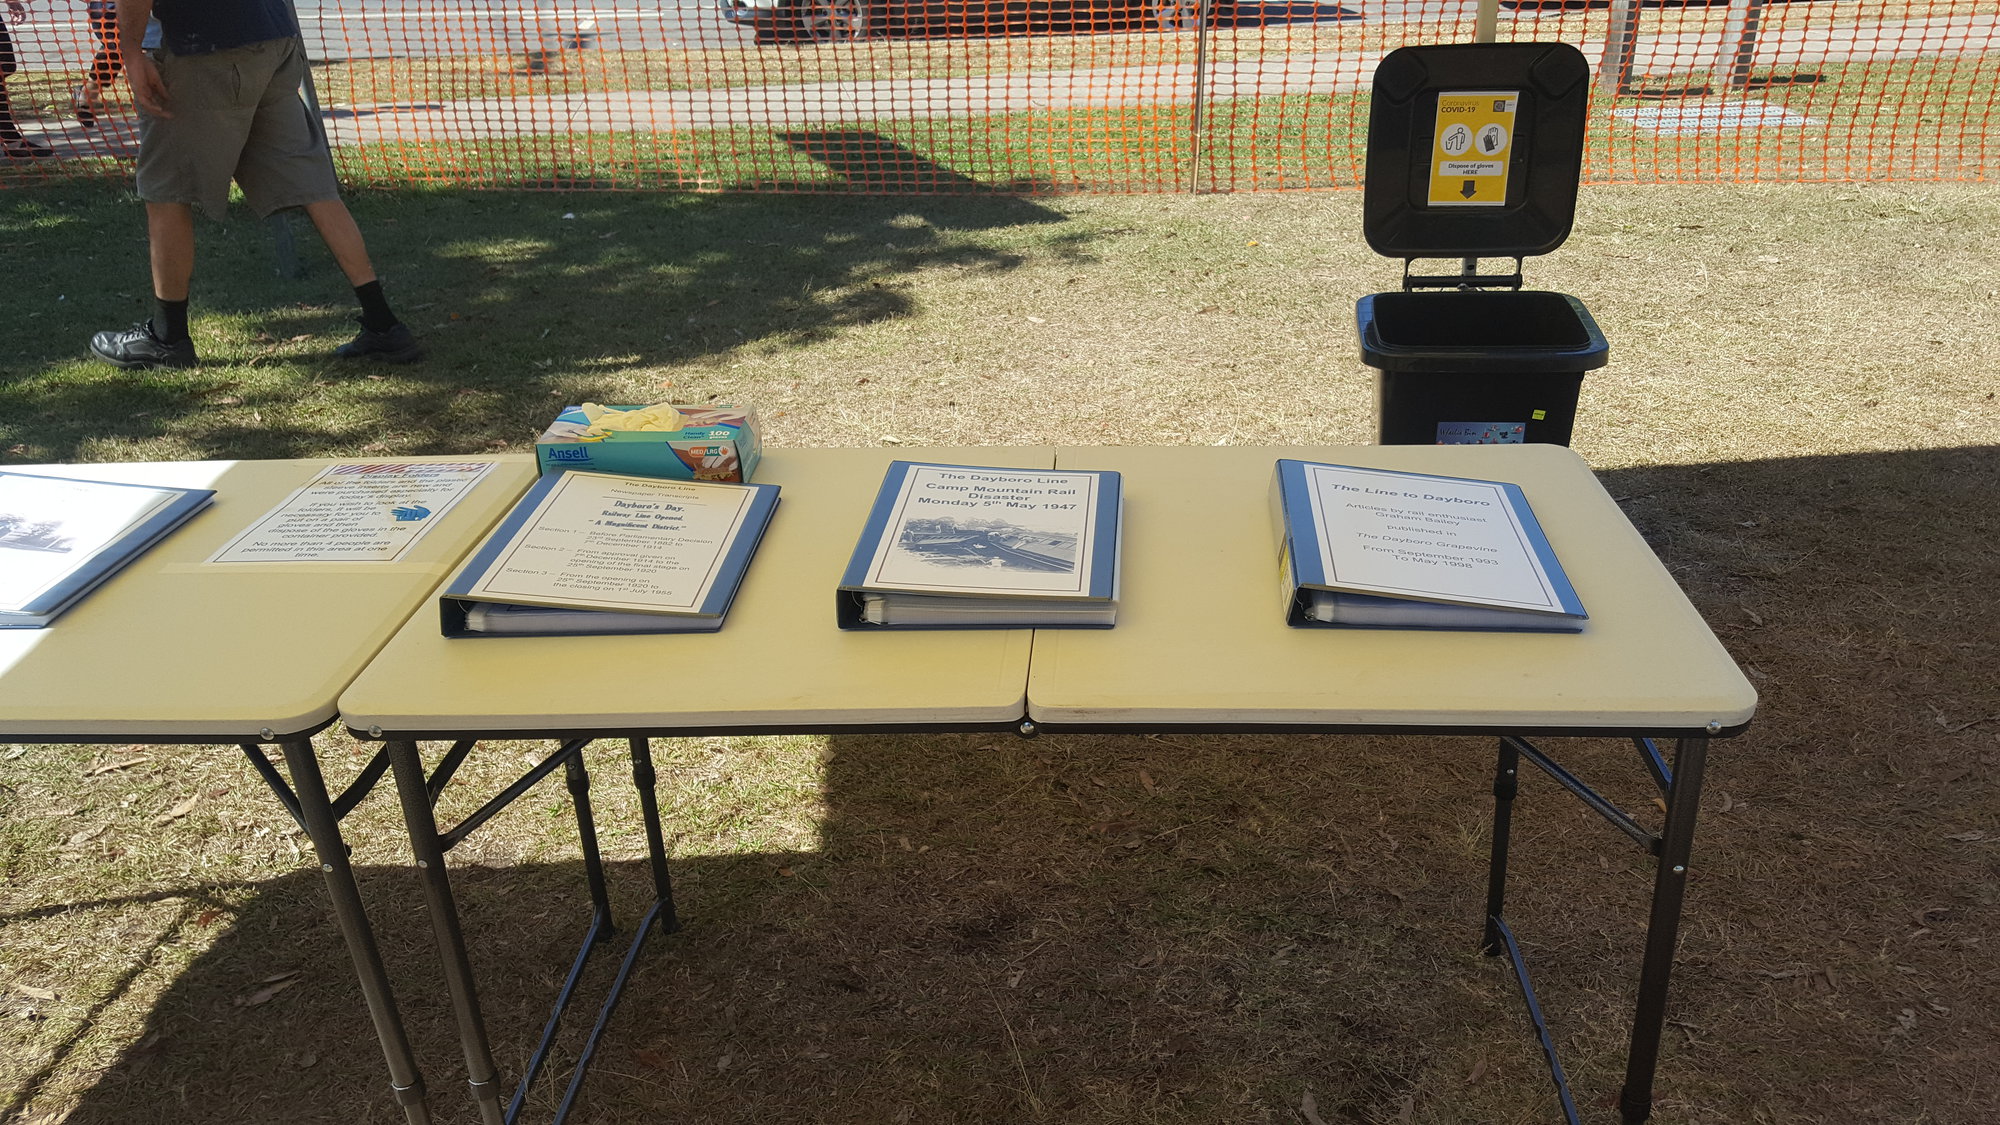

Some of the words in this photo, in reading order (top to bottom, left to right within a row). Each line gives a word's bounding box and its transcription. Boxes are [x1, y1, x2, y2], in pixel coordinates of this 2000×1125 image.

[548, 447, 588, 458] Ansell
[971, 474, 1032, 485] Dayboro
[610, 488, 655, 496] Newspaper
[658, 492, 699, 500] Transcripts
[926, 483, 969, 492] Camp
[974, 486, 1042, 495] Mountain
[1332, 484, 1359, 492] The
[1365, 487, 1398, 496] Line
[1424, 494, 1490, 506] Dayboro
[968, 493, 1031, 501] Disaster
[614, 500, 660, 510] Dayboro's
[665, 503, 685, 512] Day.
[918, 497, 978, 507] Monday
[1006, 502, 1036, 510] May
[602, 510, 631, 518] Railway
[1346, 503, 1387, 512] Articles
[1428, 512, 1487, 523] enthusiast
[1376, 511, 1422, 521] Graham
[1425, 517, 1460, 526] Bailey
[605, 520, 648, 529] Magnificent
[1387, 525, 1442, 535] published
[619, 533, 676, 542] Parliamentary
[1382, 535, 1432, 546] Dayboro
[1437, 541, 1498, 553] Grapevine
[1363, 545, 1394, 554] From
[1398, 549, 1464, 561] September
[1469, 557, 1499, 566] 1993
[586, 564, 633, 572] September
[1413, 557, 1438, 565] May
[1442, 560, 1472, 569] 1998
[506, 567, 539, 575] Section
